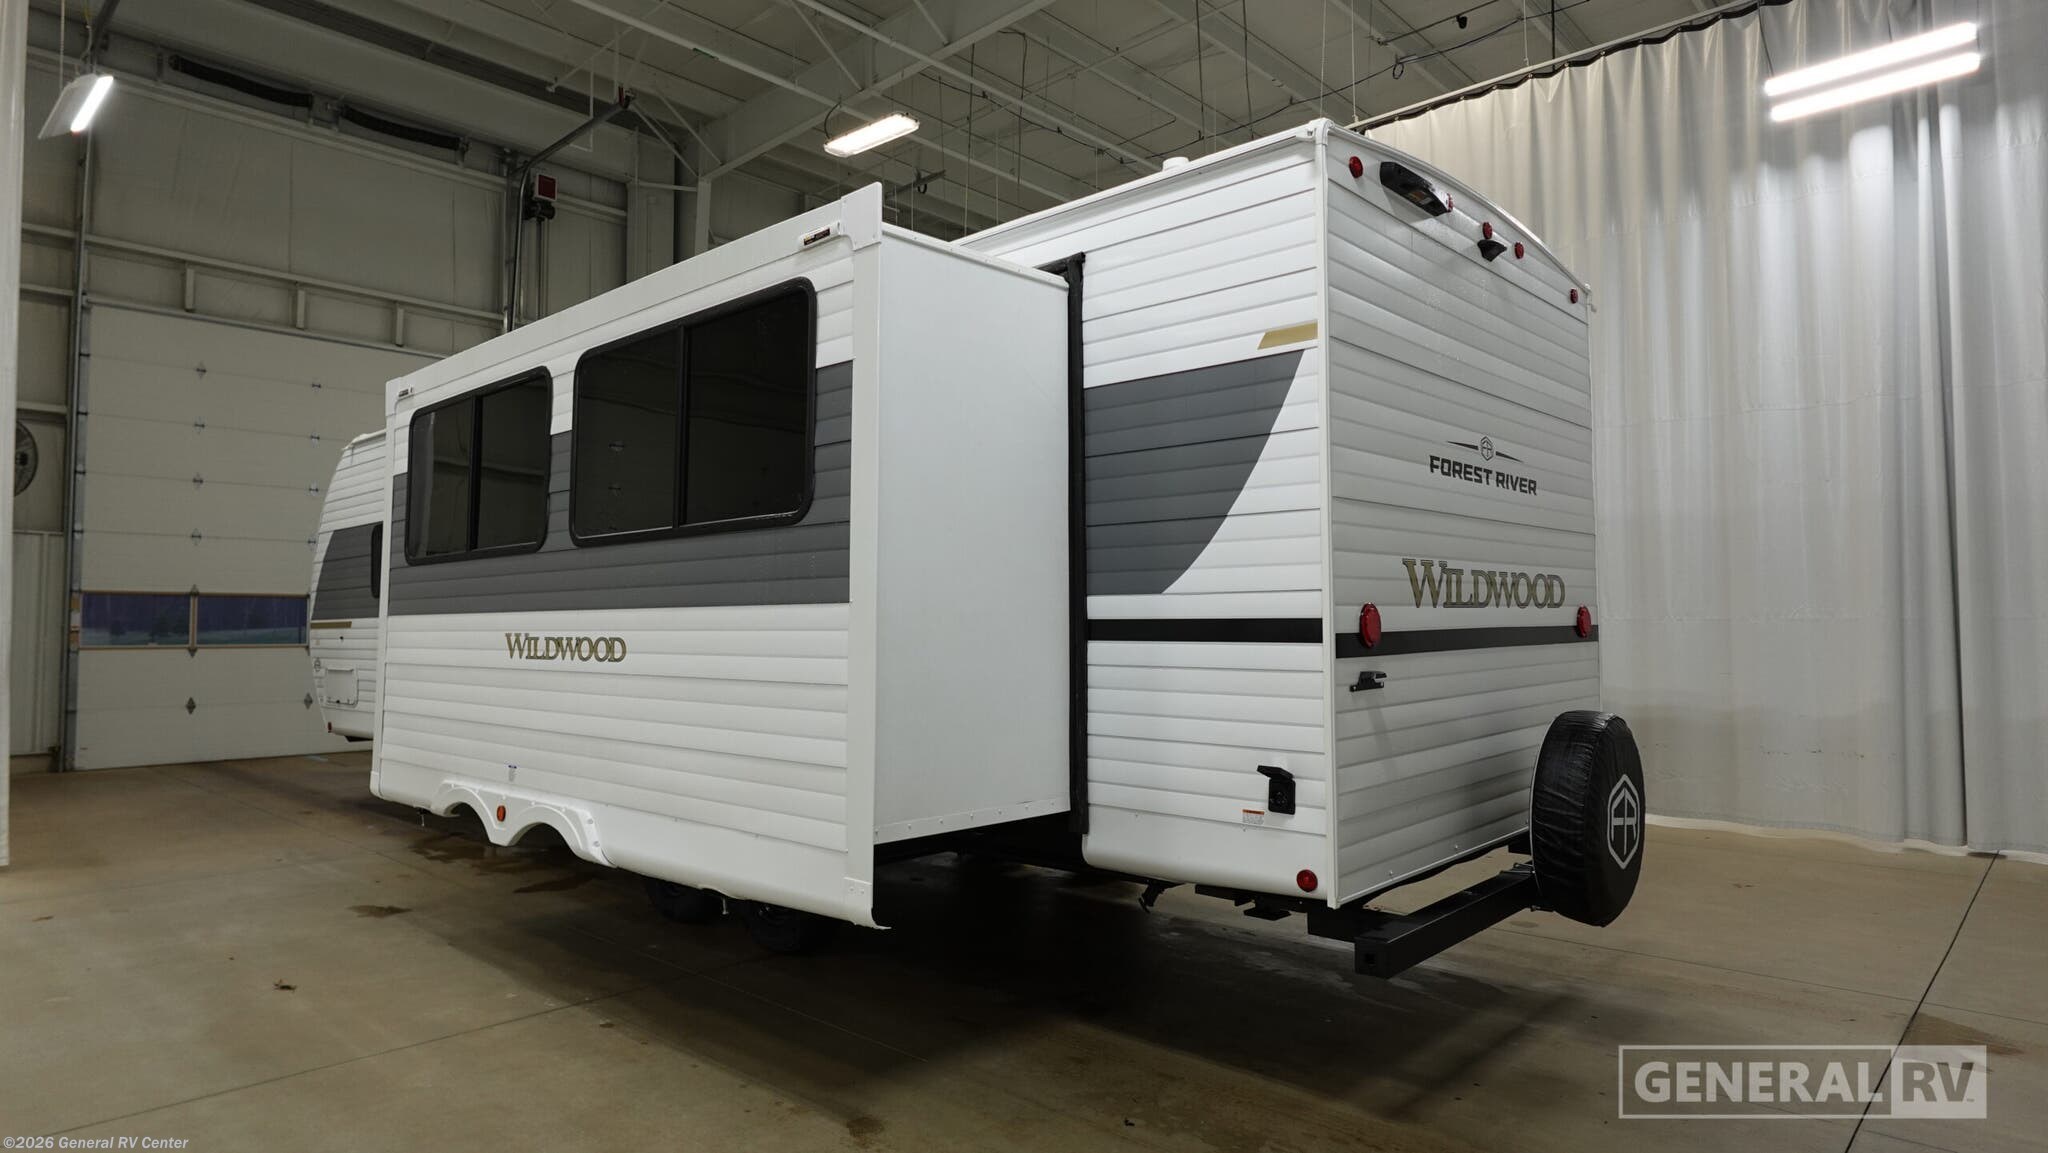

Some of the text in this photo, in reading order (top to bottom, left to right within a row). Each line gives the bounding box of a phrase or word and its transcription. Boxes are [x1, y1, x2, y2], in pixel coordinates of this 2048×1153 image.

[1429, 454, 1537, 496] FOREST RIVER
[1402, 558, 1566, 609] WILDWOOD
[504, 632, 627, 663] WILDWOOD
